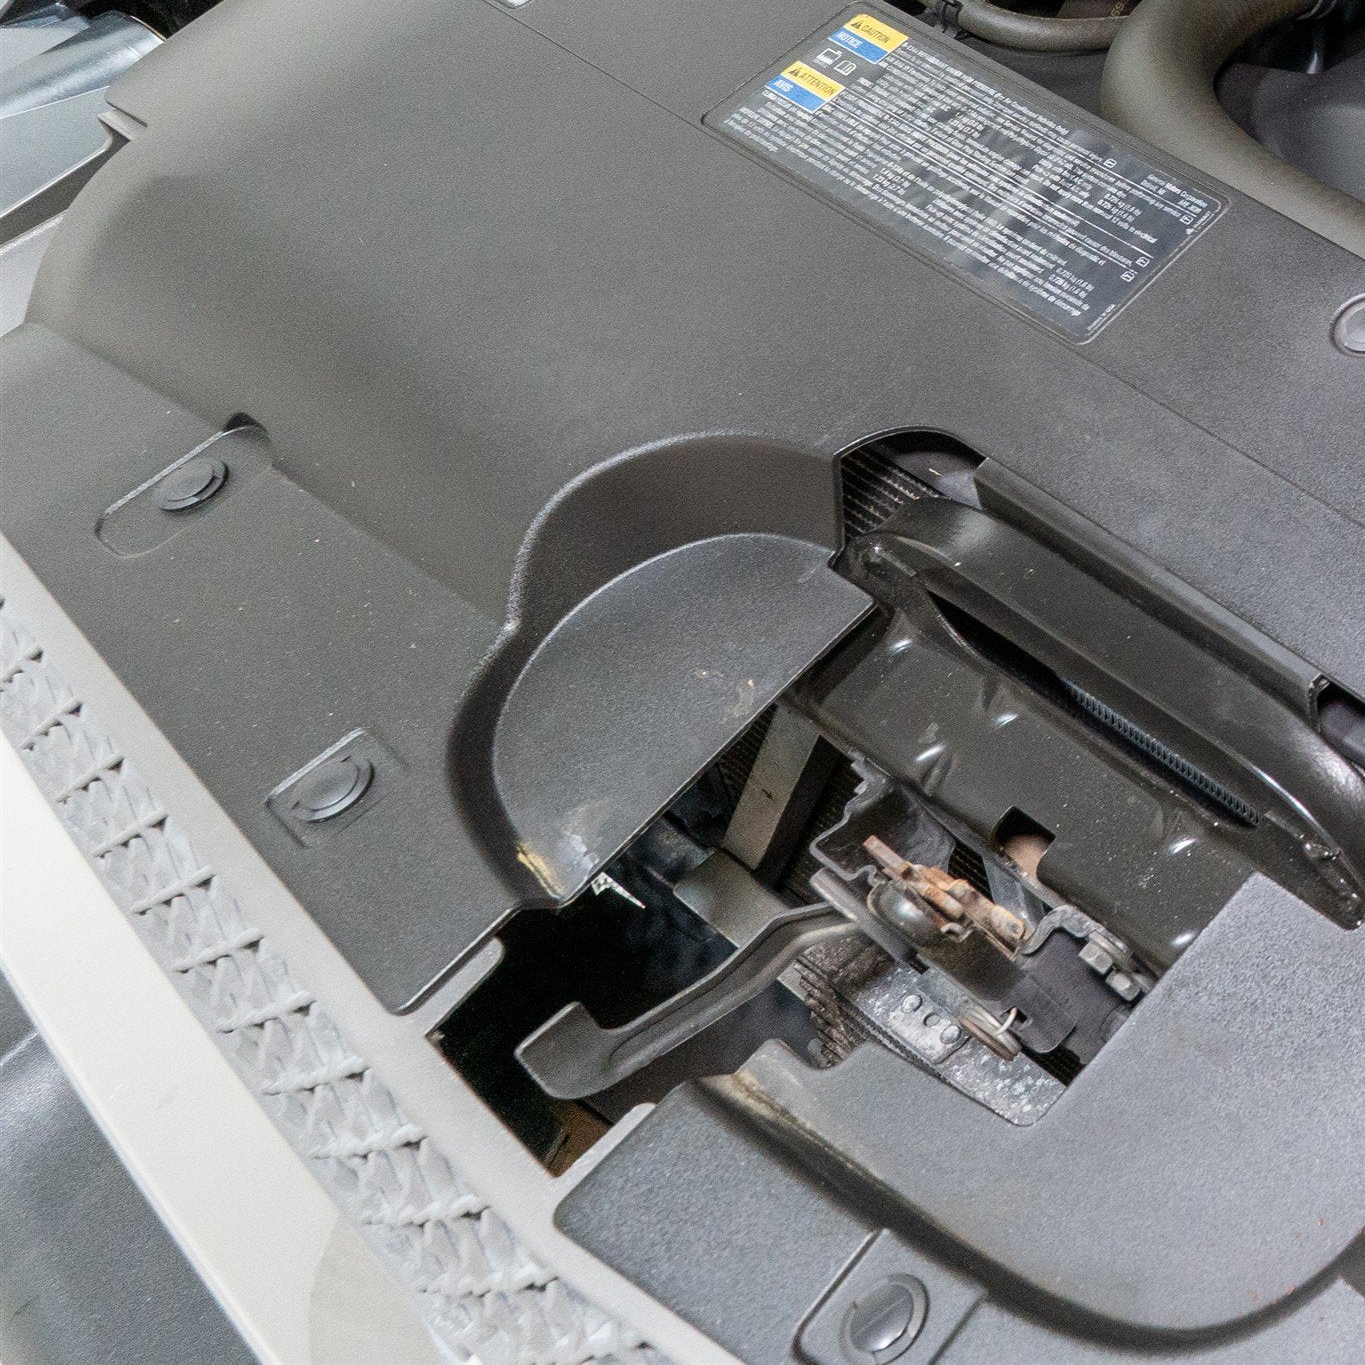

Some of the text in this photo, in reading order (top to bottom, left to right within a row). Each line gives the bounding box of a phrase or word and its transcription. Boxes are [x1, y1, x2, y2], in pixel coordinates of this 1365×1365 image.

[834, 30, 864, 49] NOTICE
[859, 24, 892, 43] CAUTION
[771, 77, 795, 93] AVIS
[796, 71, 838, 96] ATTENTION
[1146, 172, 1209, 209] General Motors Corporation
